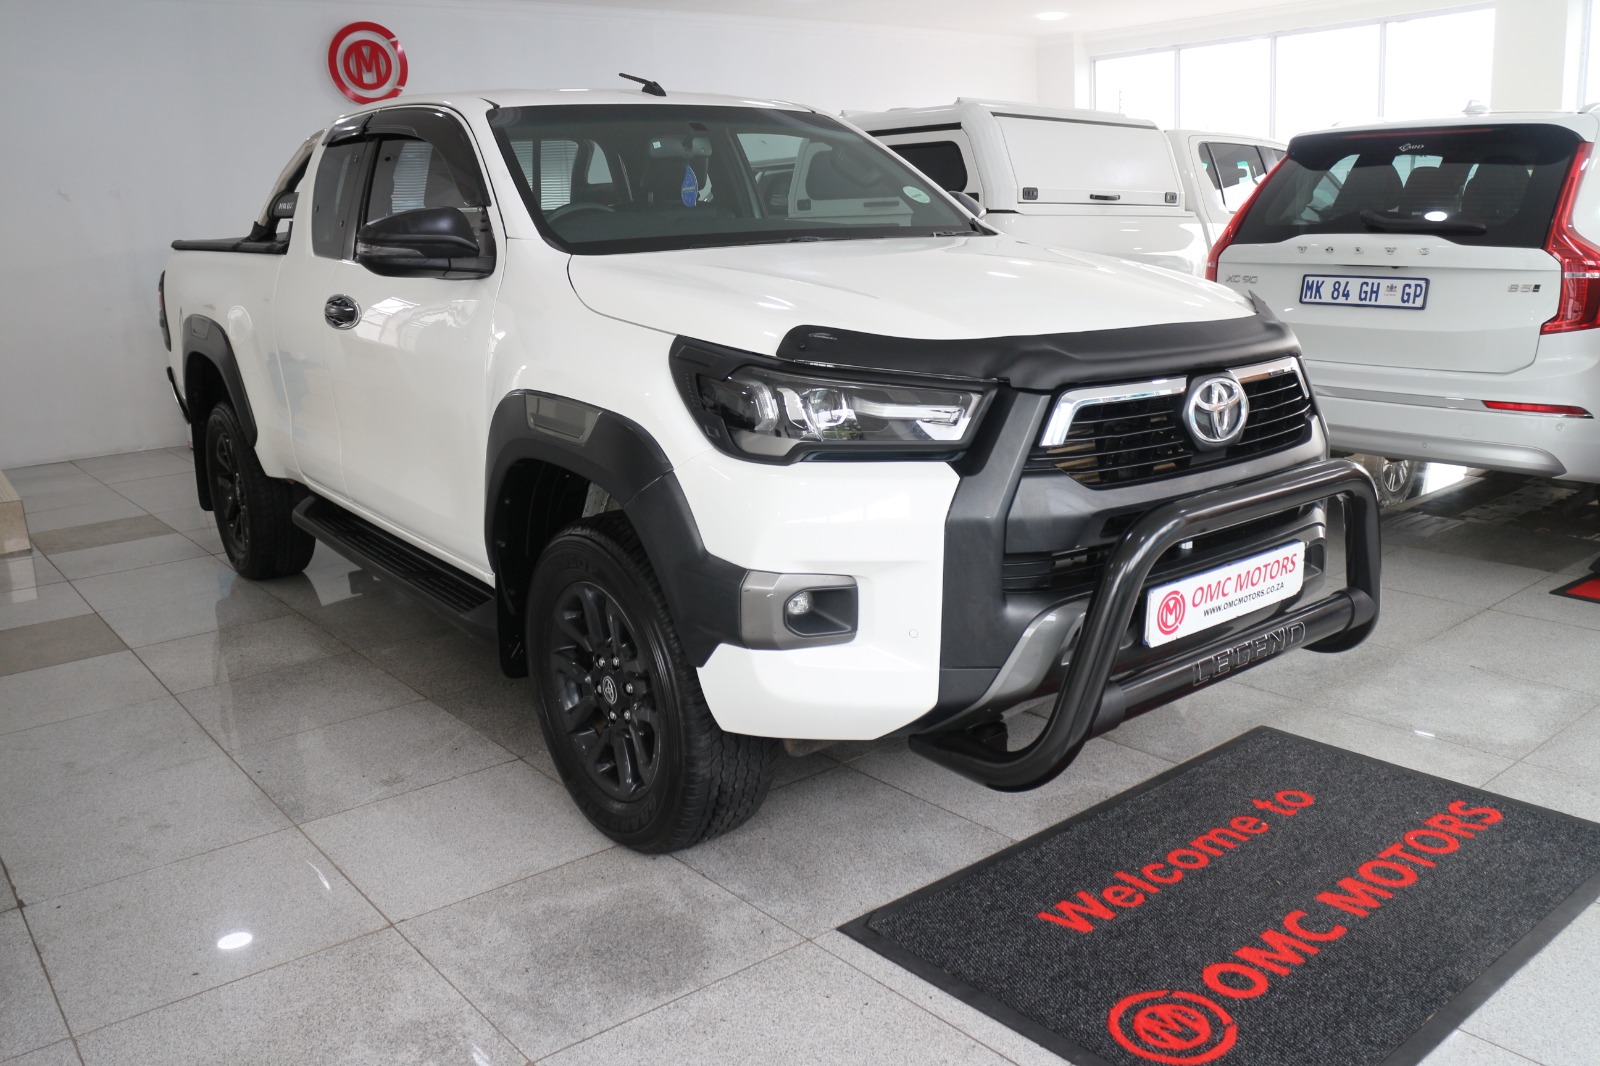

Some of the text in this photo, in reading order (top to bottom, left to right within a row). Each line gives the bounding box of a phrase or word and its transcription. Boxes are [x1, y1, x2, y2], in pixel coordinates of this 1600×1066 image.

[1297, 245, 1430, 256] VOLVO
[1303, 280, 1424, 305] MK 84 GH GP
[1191, 576, 1232, 608] OMC
[1234, 553, 1298, 593] MOTORS
[1203, 581, 1285, 618] WWW.OMCMOTORS.CO.ZA
[1192, 622, 1306, 687] LEGEND
[1035, 790, 1315, 933] Welcome to
[1202, 909, 1348, 999] OMC
[1315, 800, 1503, 917] MOTORS
